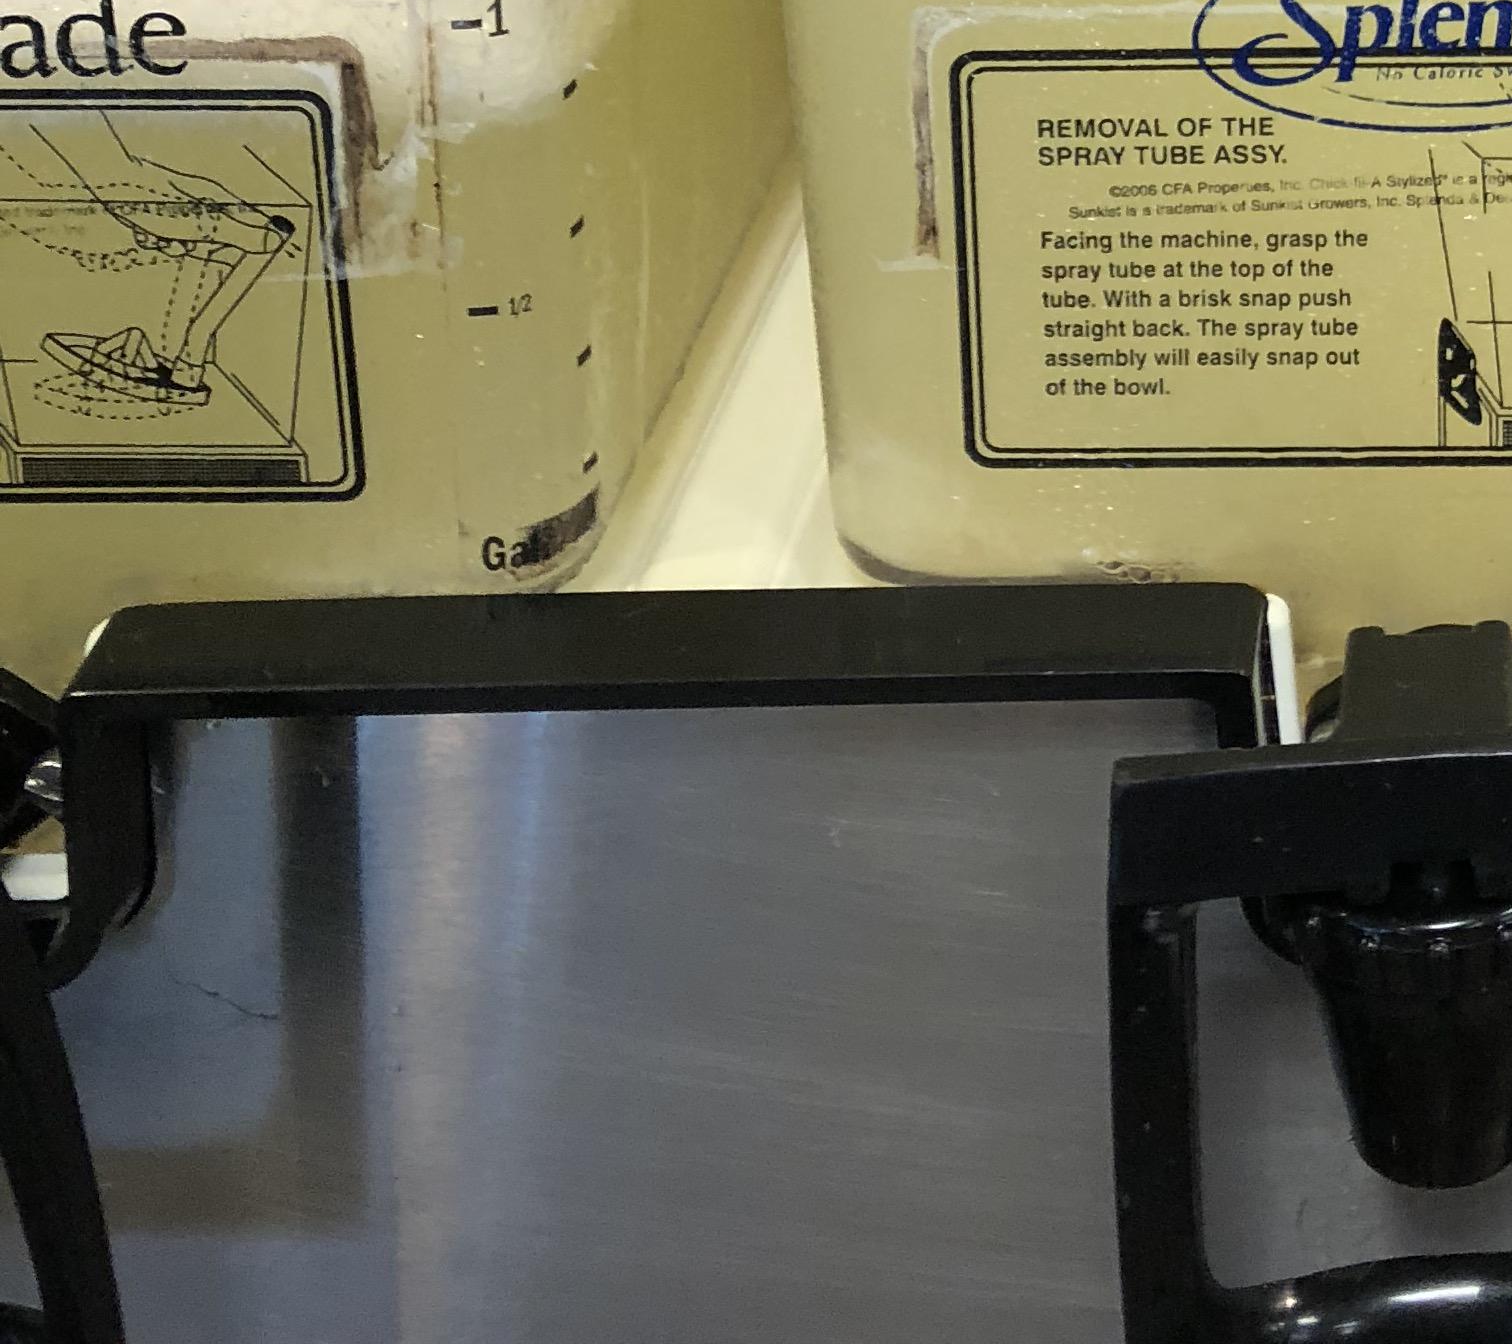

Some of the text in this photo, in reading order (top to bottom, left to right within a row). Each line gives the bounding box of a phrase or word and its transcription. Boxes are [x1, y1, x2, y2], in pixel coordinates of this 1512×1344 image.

[483, 0, 510, 39] 1
[1037, 116, 1275, 139] REMOVAL OF THE
[1038, 144, 1288, 168] SPRAY TUBE ASSY.
[1161, 183, 1193, 196] CFA
[1040, 228, 1369, 254] Facing the machine, grasp the
[1041, 259, 1334, 283] spray tube at the top of the
[1041, 288, 1352, 312] tube. With a brisk snap push
[1043, 318, 1359, 343] straight back. The spray tube
[1045, 348, 1361, 371] assembly will easily snap out
[1045, 377, 1171, 397] of the bowl.
